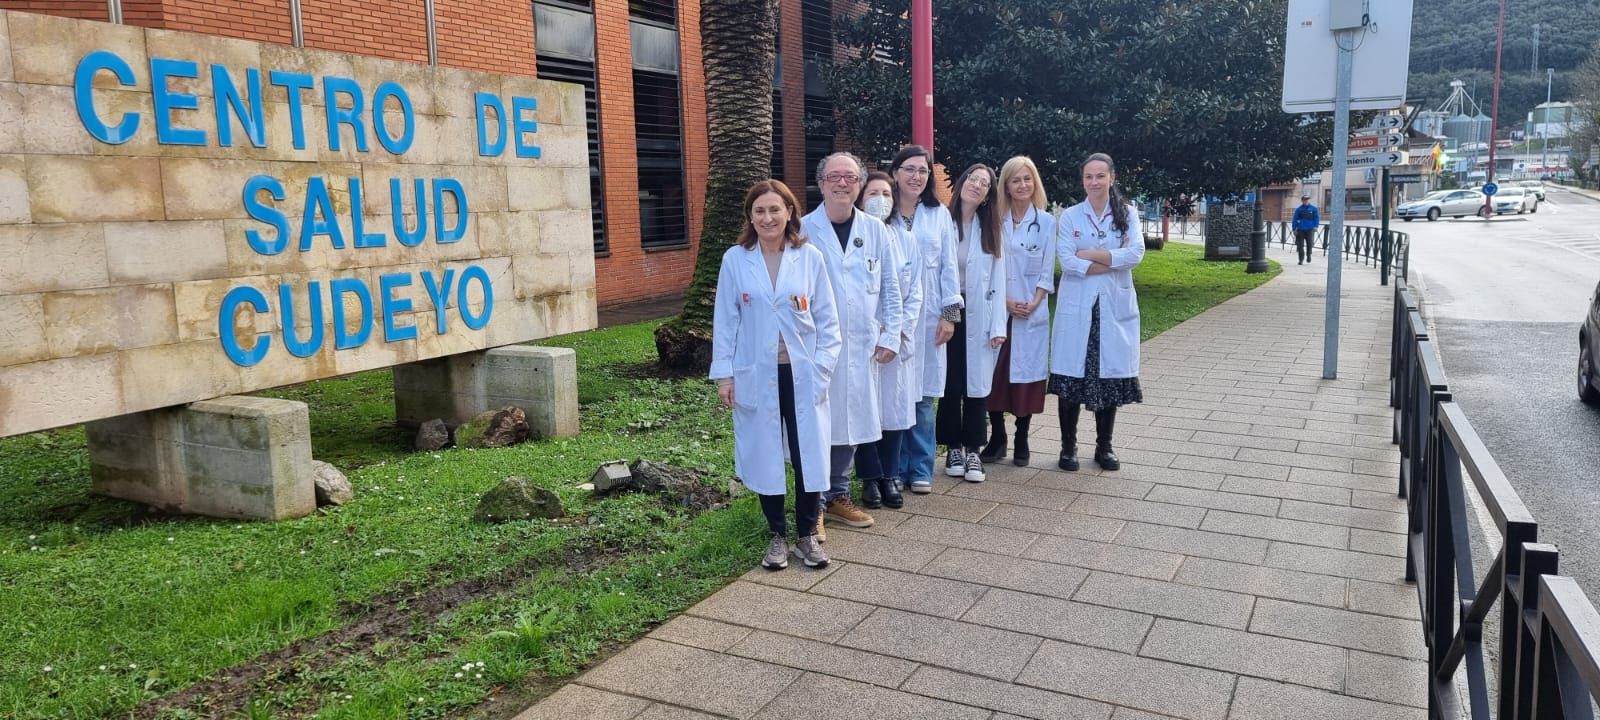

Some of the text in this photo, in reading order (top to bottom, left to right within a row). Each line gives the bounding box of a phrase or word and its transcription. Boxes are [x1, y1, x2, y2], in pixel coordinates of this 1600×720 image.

[74, 50, 541, 158] CENTRO DE
[1348, 139, 1374, 147] ortivo
[1347, 156, 1375, 165] miento
[243, 175, 468, 255] SALUD
[219, 265, 493, 366] CUDEYO
